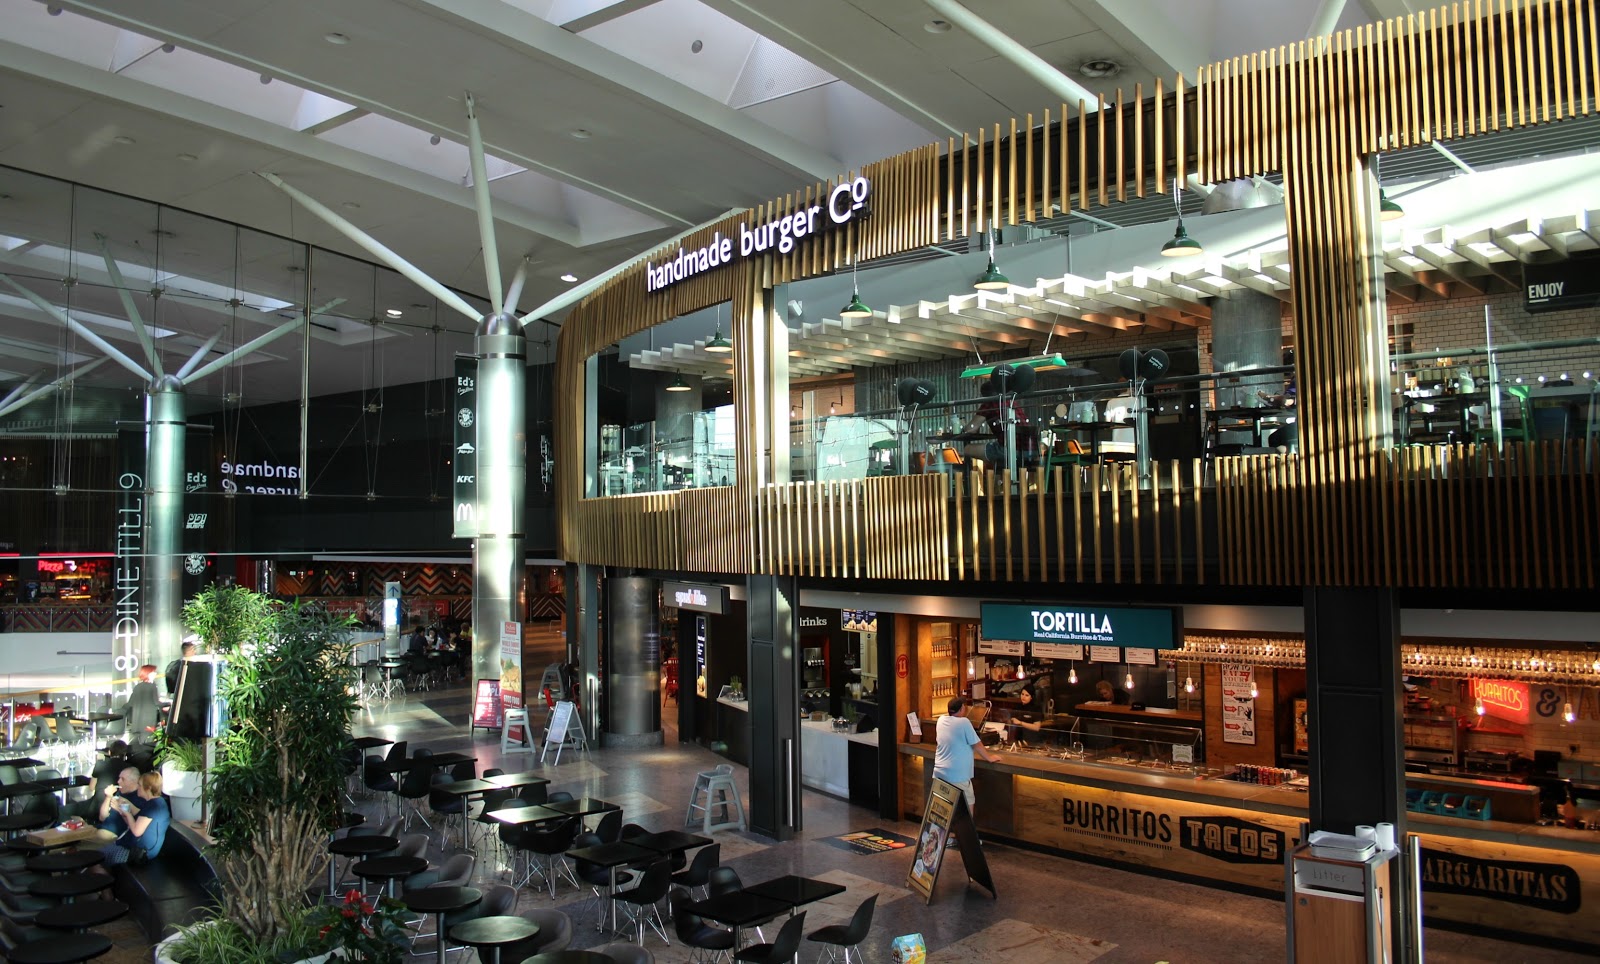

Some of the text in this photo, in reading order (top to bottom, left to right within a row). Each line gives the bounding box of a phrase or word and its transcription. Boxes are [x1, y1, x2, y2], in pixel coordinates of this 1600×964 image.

[647, 231, 732, 293] handmade
[740, 205, 820, 257] burger
[1528, 281, 1564, 299] ENJOY
[457, 376, 474, 387] Ed's
[119, 472, 143, 489] 9
[187, 471, 207, 483] Ed's
[456, 475, 475, 483] KFC
[117, 498, 142, 558] TILL
[38, 560, 64, 573] Pizza
[115, 566, 140, 640] DINE
[1031, 611, 1113, 634] TORTILLA
[1045, 632, 1070, 640] California
[1070, 633, 1092, 641] Burritos
[1473, 677, 1522, 711] BURRITOS
[1062, 797, 1568, 902] BURRITOS TACOS ARGARITAS
